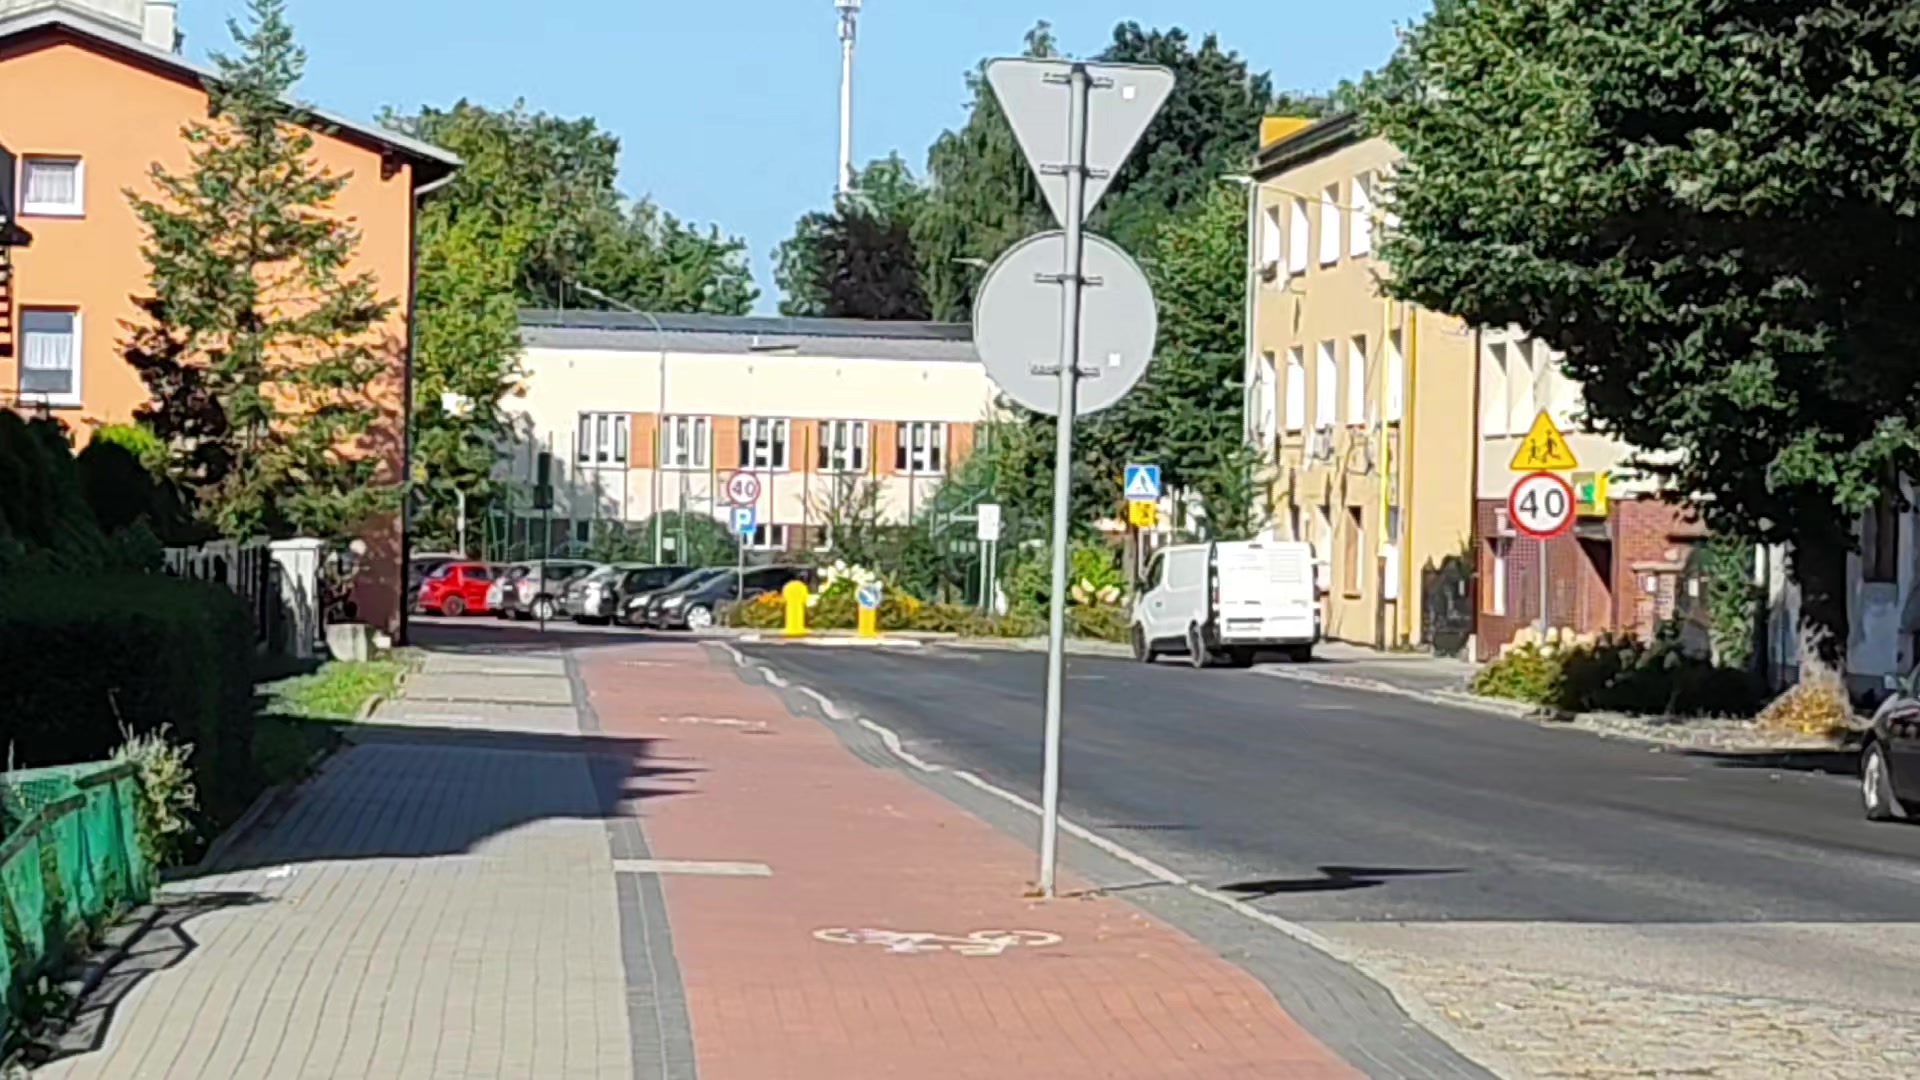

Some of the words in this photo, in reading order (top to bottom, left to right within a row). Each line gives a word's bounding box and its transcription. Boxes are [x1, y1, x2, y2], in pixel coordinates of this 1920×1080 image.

[732, 480, 756, 497] 40
[1519, 488, 1565, 518] 40
[735, 509, 751, 531] P
